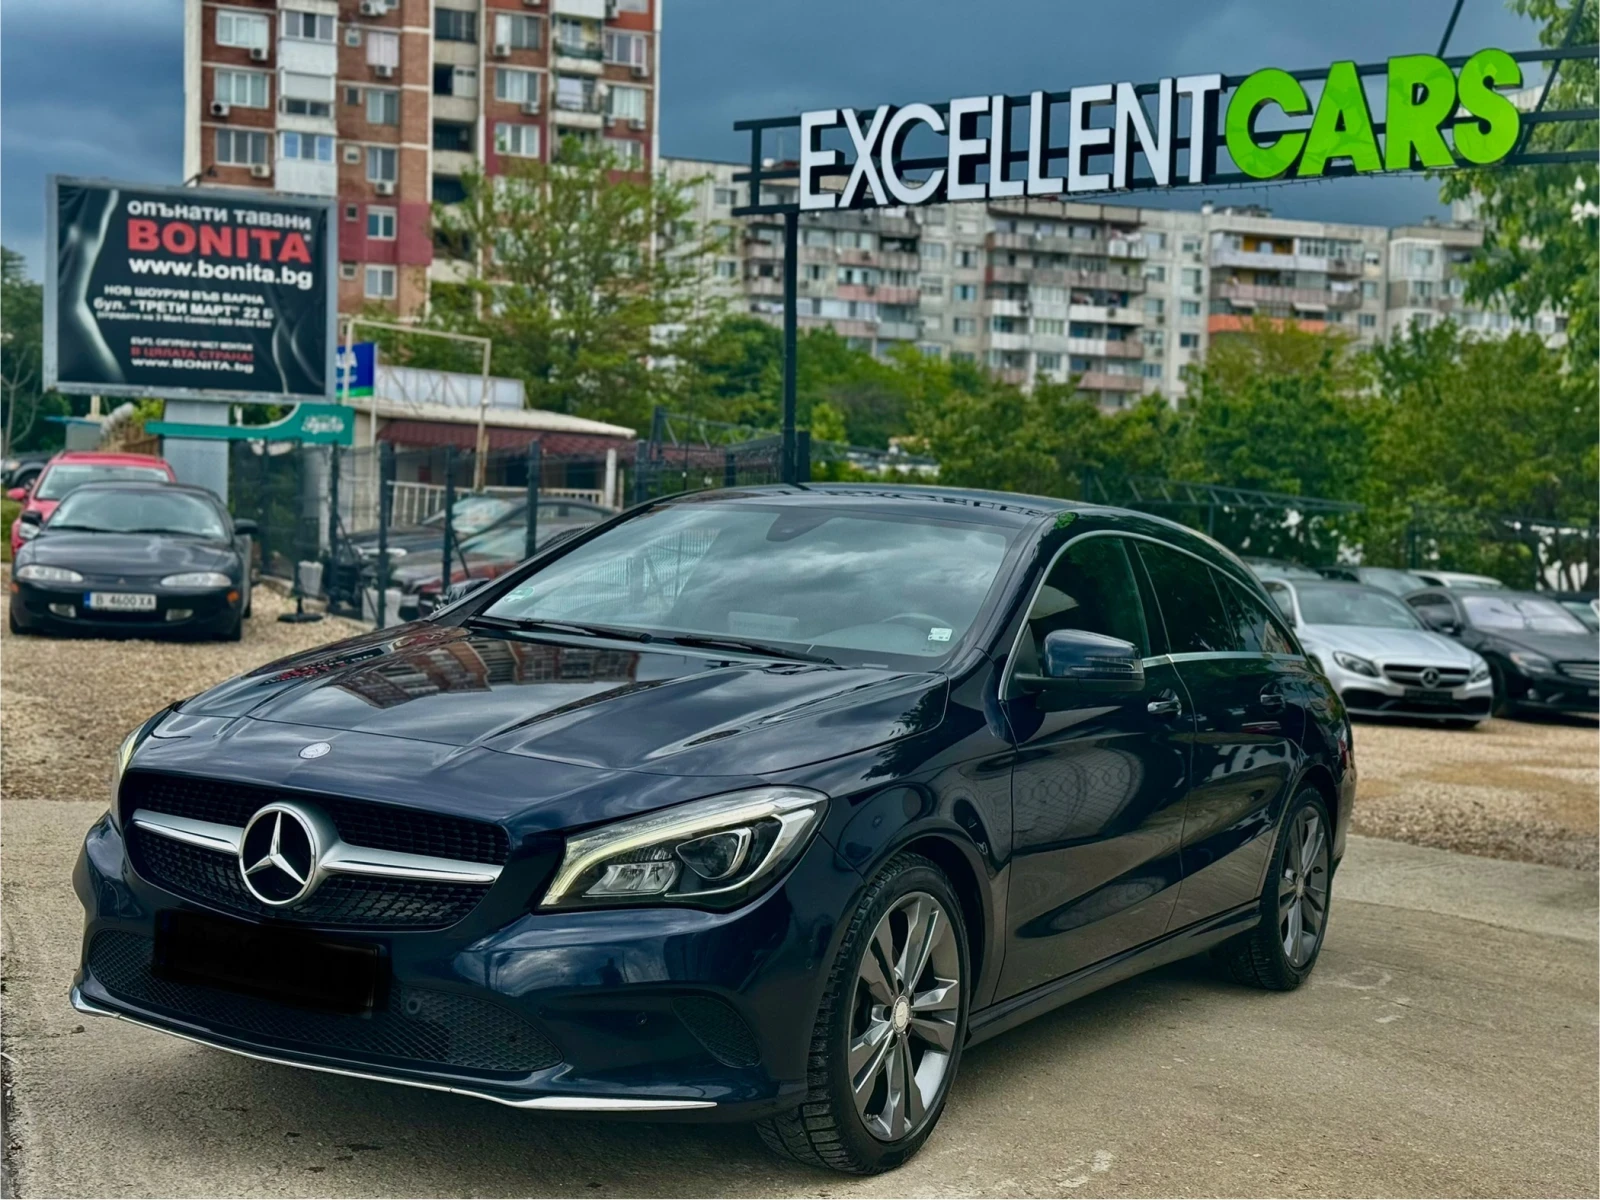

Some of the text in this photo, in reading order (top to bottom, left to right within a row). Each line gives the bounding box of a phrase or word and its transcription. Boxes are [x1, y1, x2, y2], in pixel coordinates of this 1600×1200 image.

[800, 48, 1524, 211] EXCELLENT CARS
[127, 200, 312, 230] опънати тавани
[127, 218, 312, 263] BONITA
[128, 257, 313, 290] www.bonita.bg
[93, 297, 126, 312] бул.
[243, 307, 259, 319] 22
[104, 285, 264, 305] НОВ ШОУРУМ ВЪВ ВАРНА
[131, 358, 254, 374] www.BONITA.bg
[144, 347, 196, 359] ЦЯЛАТА
